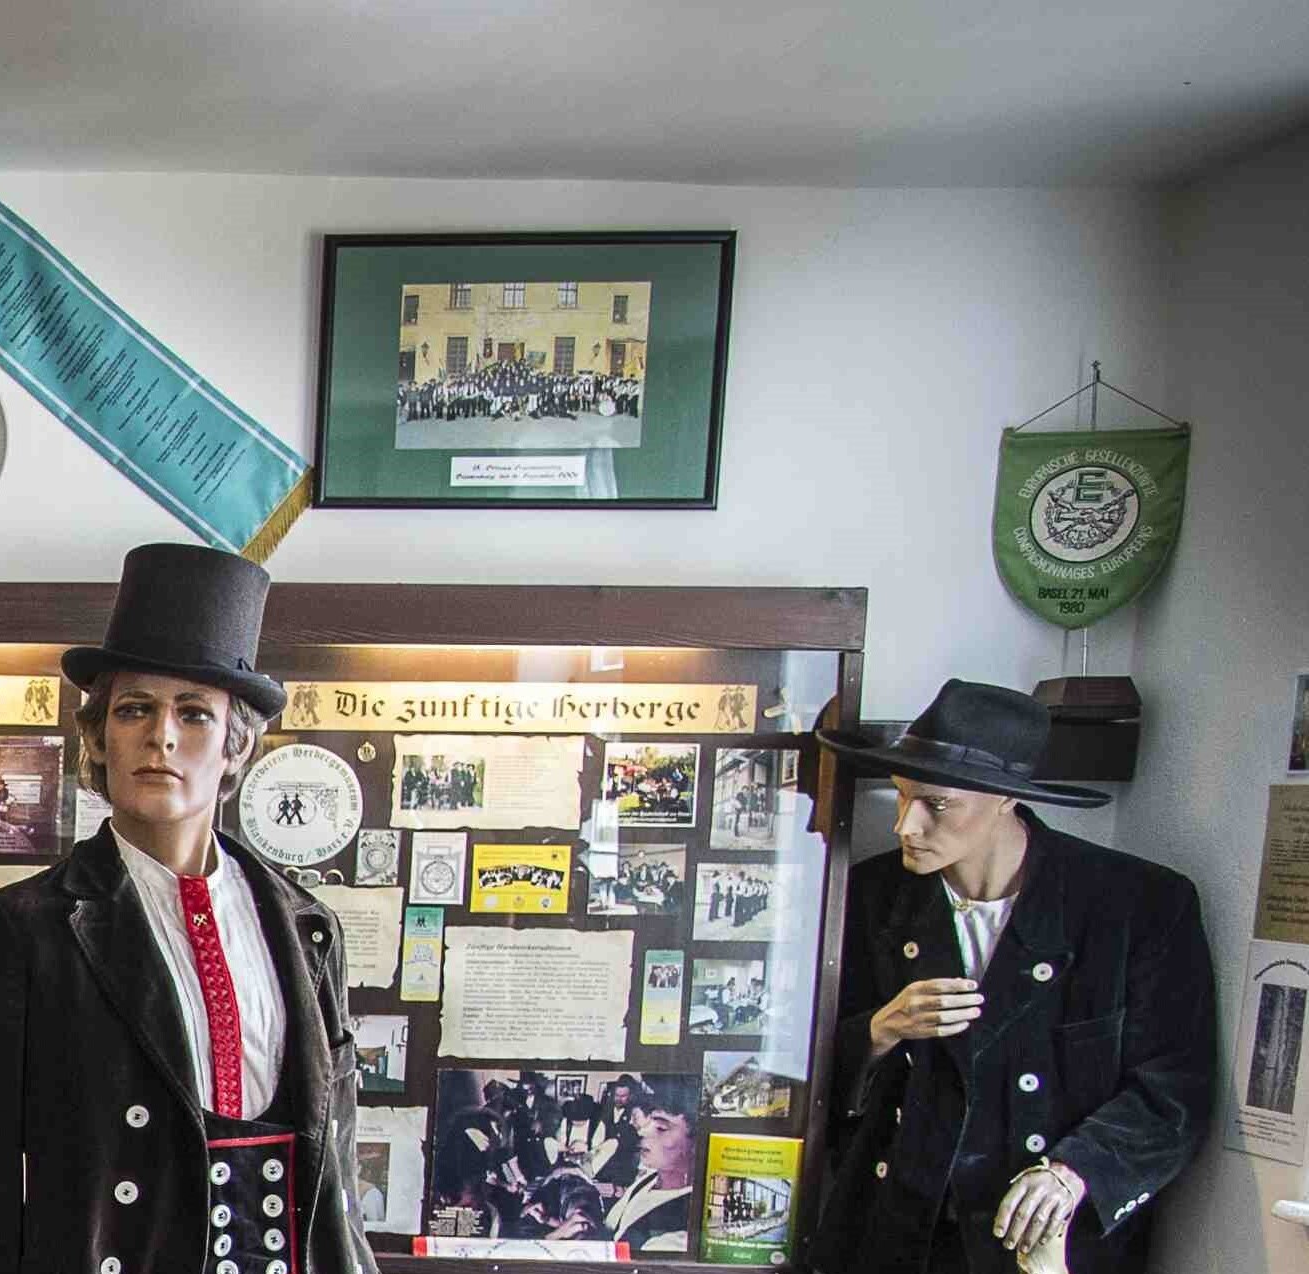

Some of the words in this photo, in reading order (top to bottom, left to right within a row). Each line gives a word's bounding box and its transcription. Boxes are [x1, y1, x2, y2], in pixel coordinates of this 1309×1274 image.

[1038, 587, 1070, 600] BASEL
[1087, 587, 1110, 600] MAI
[1059, 601, 1086, 614] 1980
[335, 689, 386, 718] Die
[551, 695, 701, 727] Herberge
